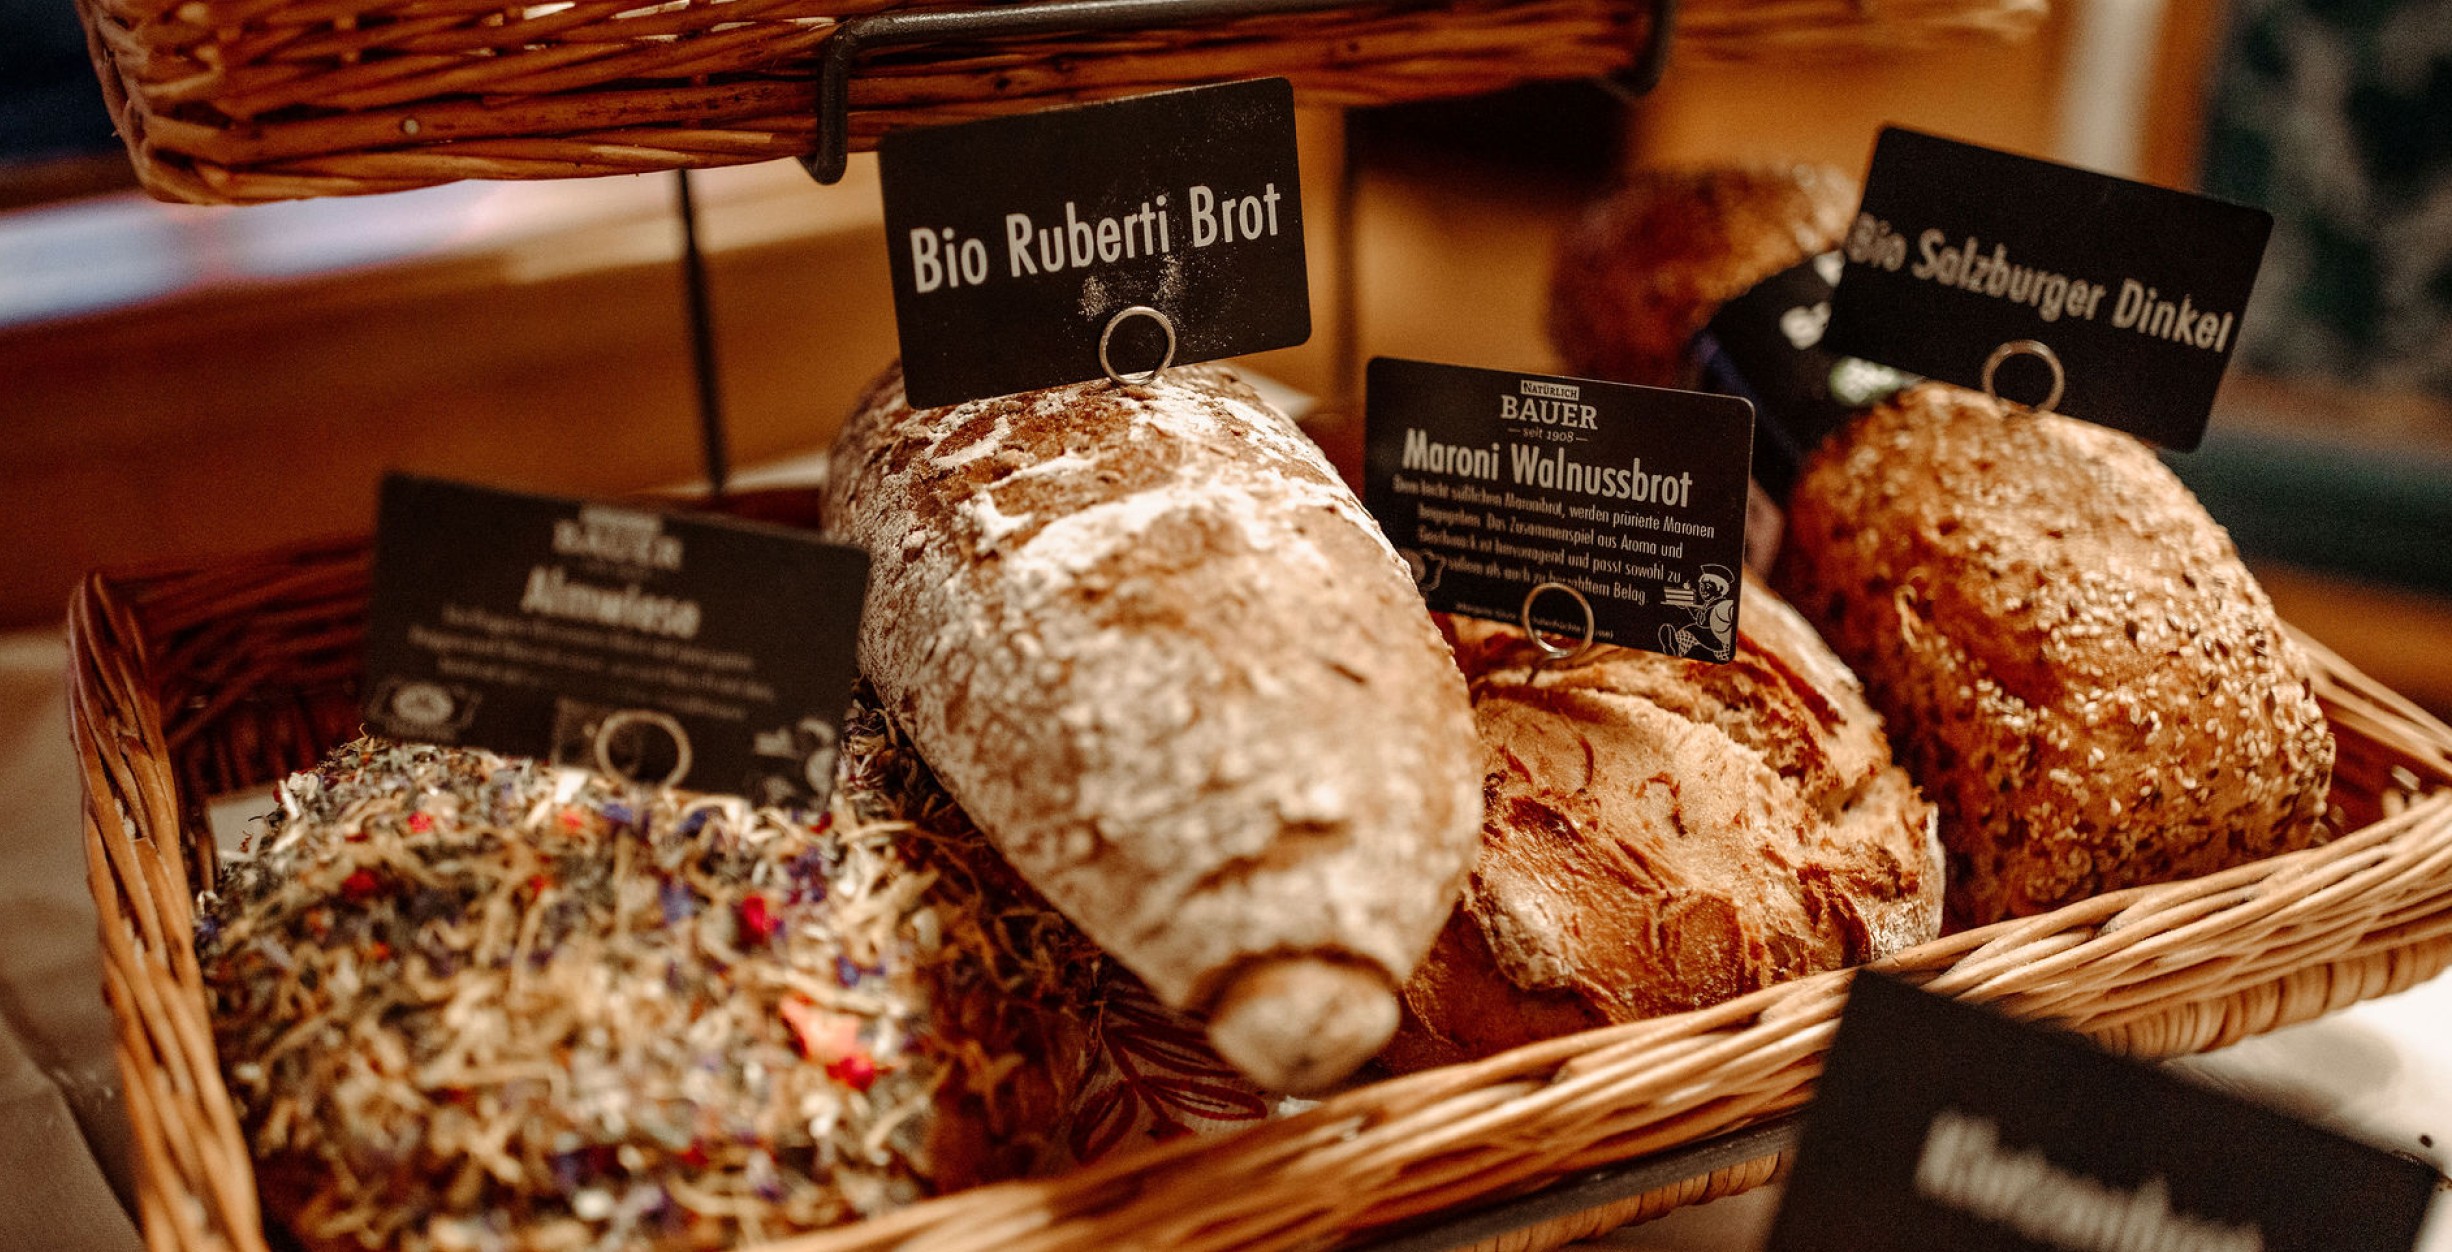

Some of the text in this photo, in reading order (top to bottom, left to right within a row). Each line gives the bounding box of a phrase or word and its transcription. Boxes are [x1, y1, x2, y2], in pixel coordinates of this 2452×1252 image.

[910, 182, 1281, 293] Bio Ruberti Brot
[1846, 212, 2234, 353] Bio Salzburger Dinkel
[1501, 394, 1598, 430] BAUER
[1547, 431, 1574, 443] 1908
[1402, 427, 1693, 508] Maroni Walnussbrot
[1509, 515, 1594, 546] Zusammenspiel
[1597, 534, 1617, 548] aus
[1620, 534, 1657, 555] Aroma
[1661, 542, 1684, 559] und
[1569, 504, 1610, 523] werden
[1663, 515, 1715, 539] Maronen
[1568, 552, 1589, 569] und
[1592, 559, 1621, 575] passt
[1625, 562, 1664, 581] sowohl
[1667, 570, 1681, 584] zu
